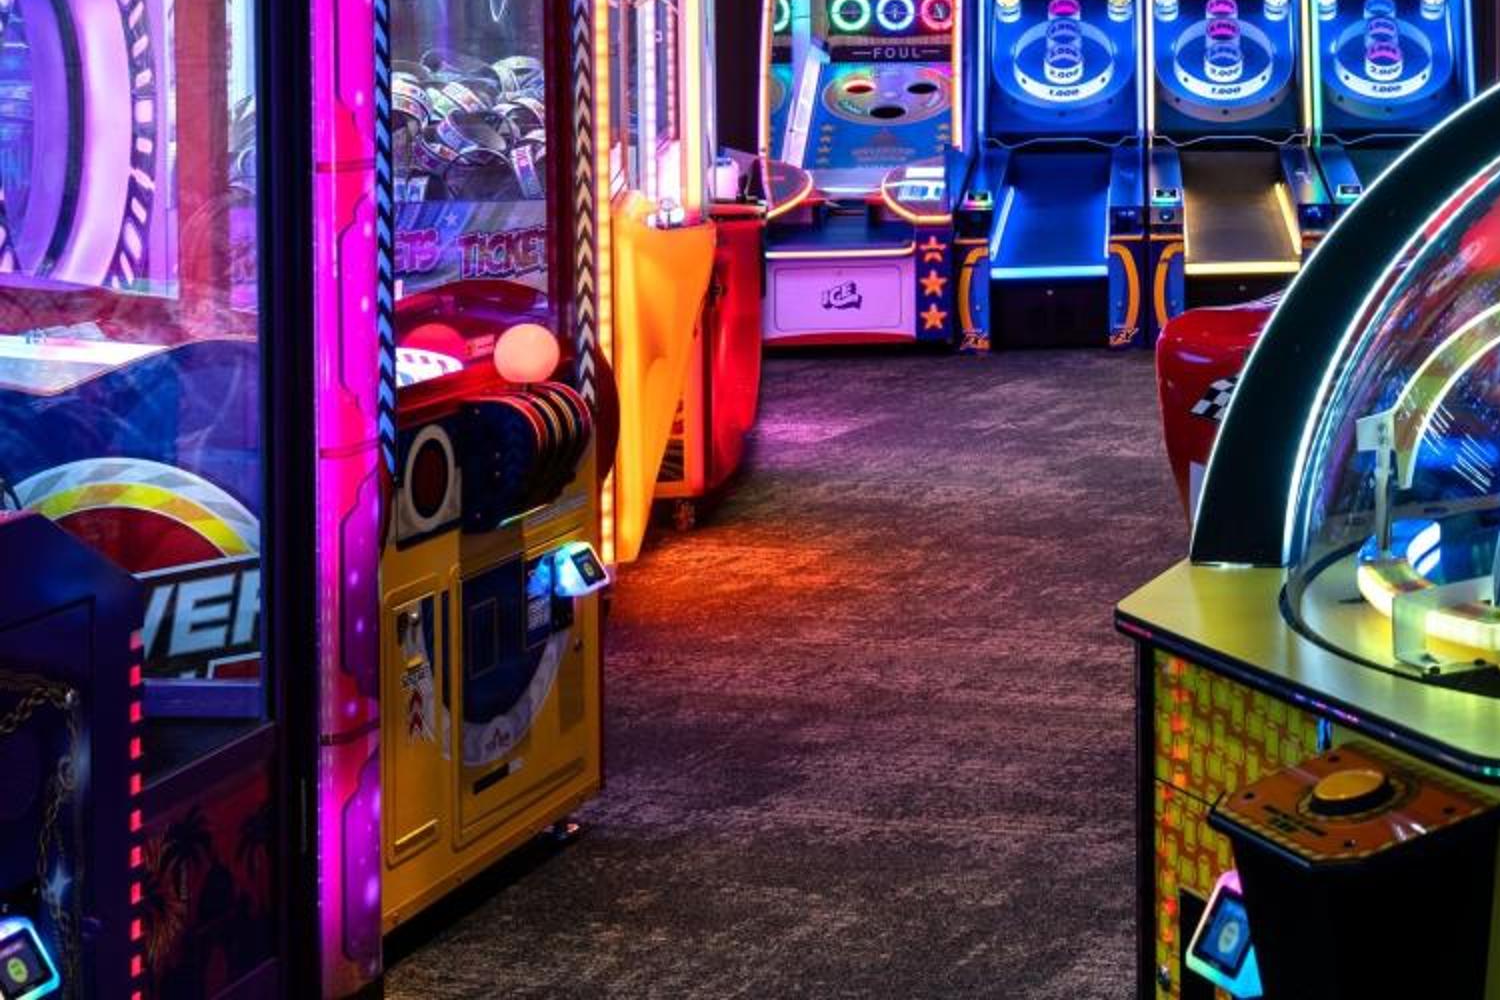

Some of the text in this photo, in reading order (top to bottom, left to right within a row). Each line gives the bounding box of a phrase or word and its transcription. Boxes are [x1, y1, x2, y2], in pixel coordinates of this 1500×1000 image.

[873, 48, 921, 59] FOUL
[456, 225, 546, 281] TICKE
[822, 281, 862, 310] ICE
